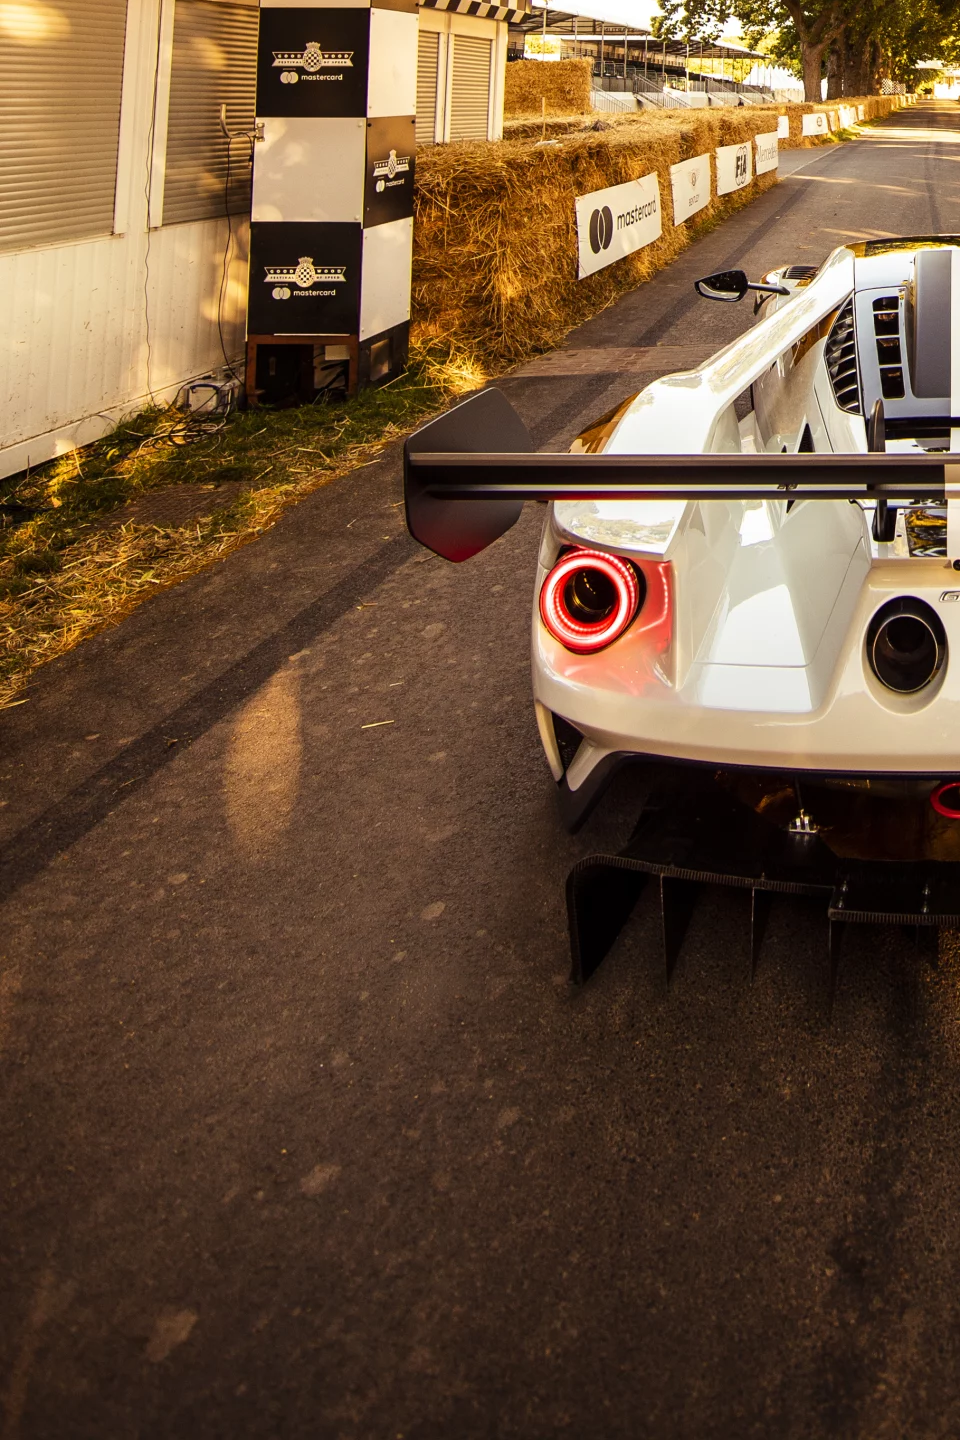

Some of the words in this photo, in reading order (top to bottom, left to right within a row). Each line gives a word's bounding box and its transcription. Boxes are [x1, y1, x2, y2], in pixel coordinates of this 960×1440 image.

[301, 73, 343, 81] mastercard
[616, 194, 657, 230] mastercard
[293, 288, 336, 296] mastercard
